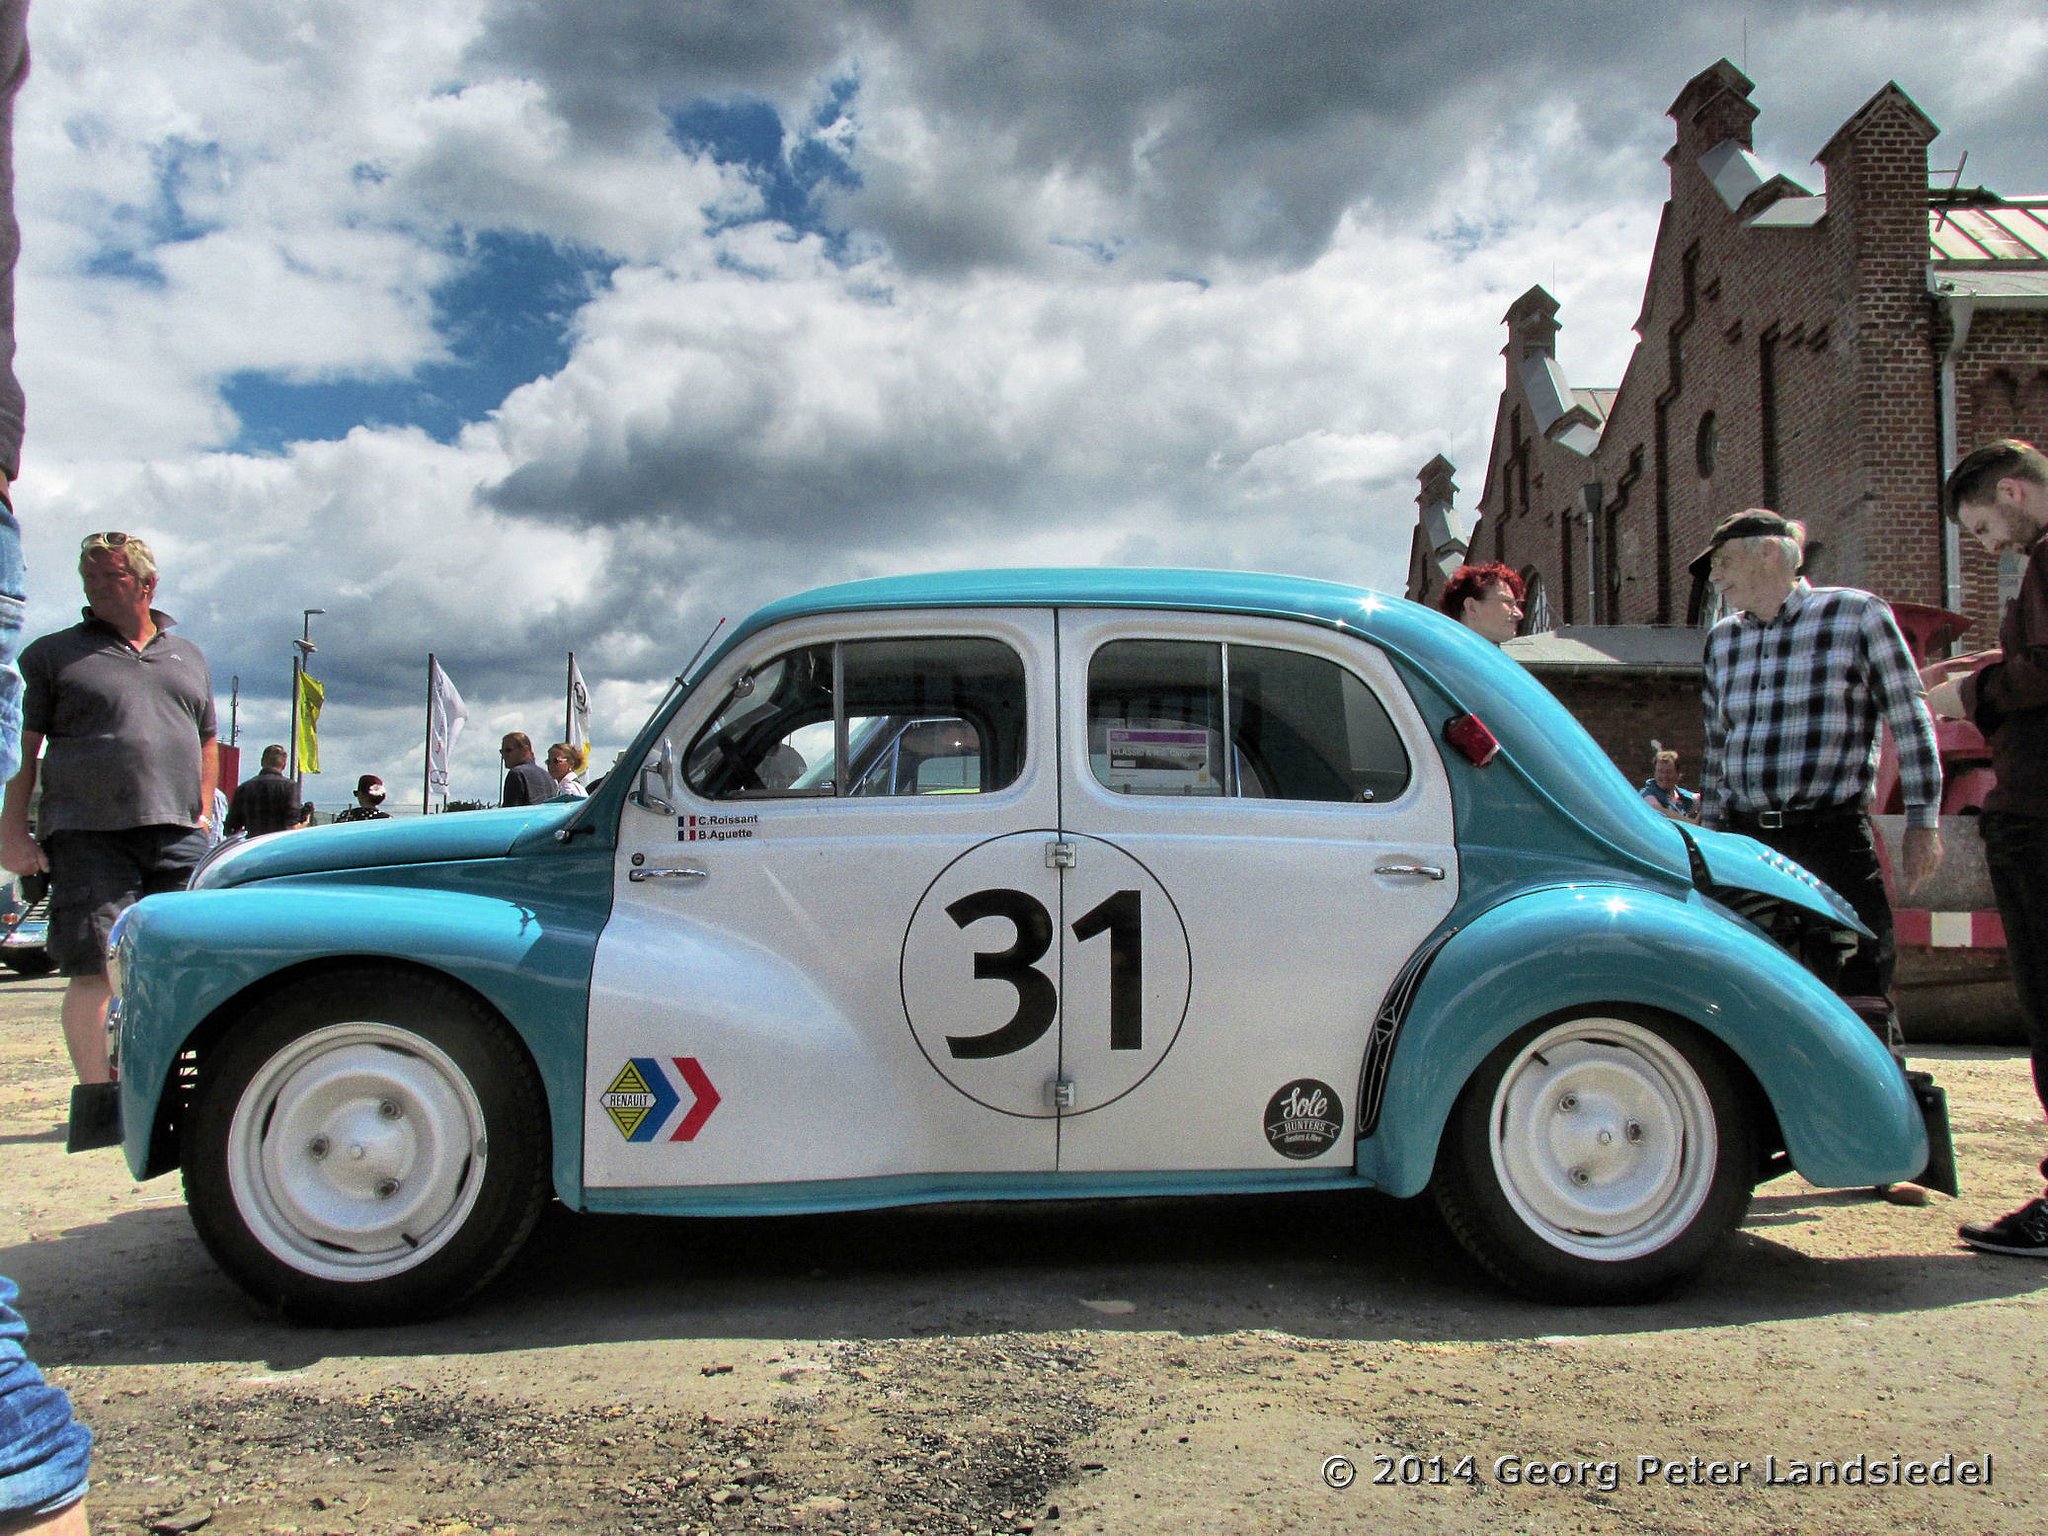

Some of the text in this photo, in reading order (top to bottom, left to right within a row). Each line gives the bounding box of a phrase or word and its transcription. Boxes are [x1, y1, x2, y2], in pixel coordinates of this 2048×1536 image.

[698, 815, 758, 826] C.Roissant
[698, 829, 753, 841] B.Aguette
[945, 888, 1142, 1059] 31
[609, 1094, 648, 1107] RENAULT
[1280, 1087, 1328, 1119] Sole
[1285, 1120, 1326, 1132] HUNTERS
